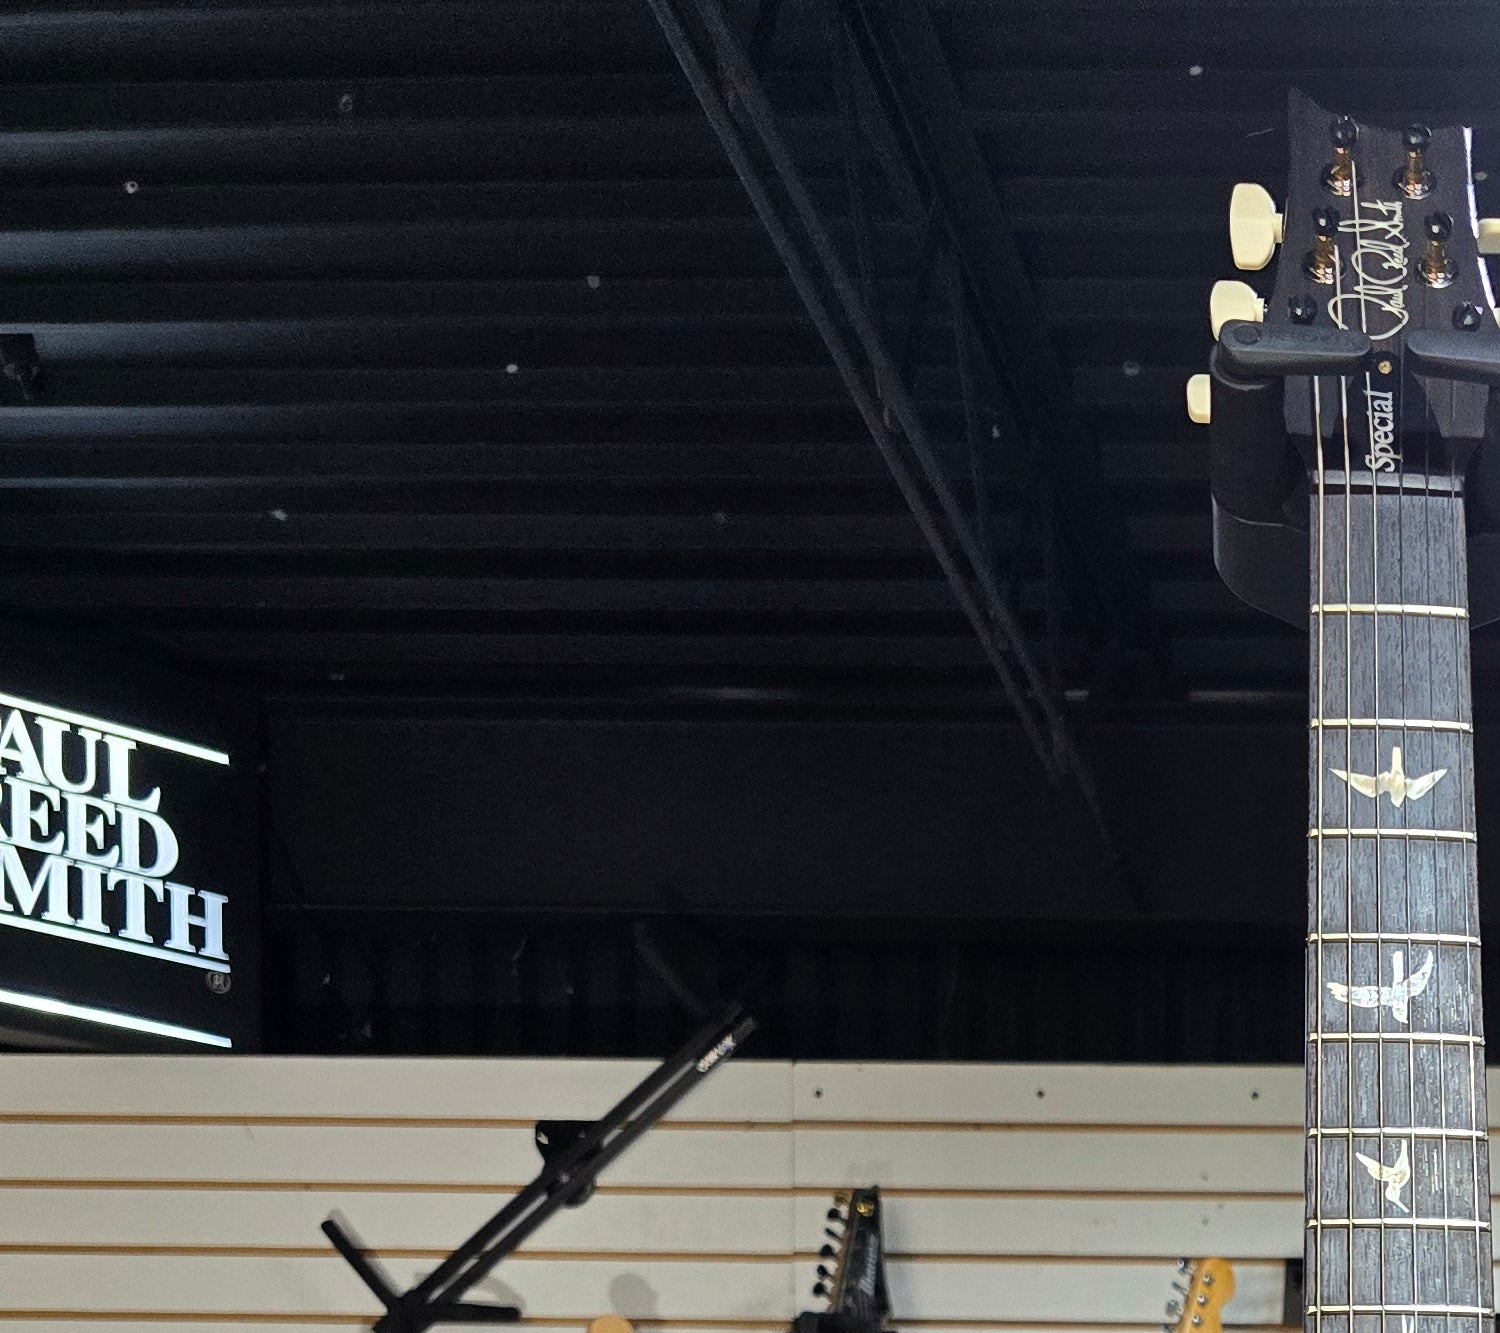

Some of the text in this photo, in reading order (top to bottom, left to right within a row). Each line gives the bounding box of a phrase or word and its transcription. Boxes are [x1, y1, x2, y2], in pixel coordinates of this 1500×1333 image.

[1364, 390, 1402, 472] Special
[0, 709, 161, 813] AUL
[0, 775, 179, 878] EED
[0, 845, 230, 960] MITH
